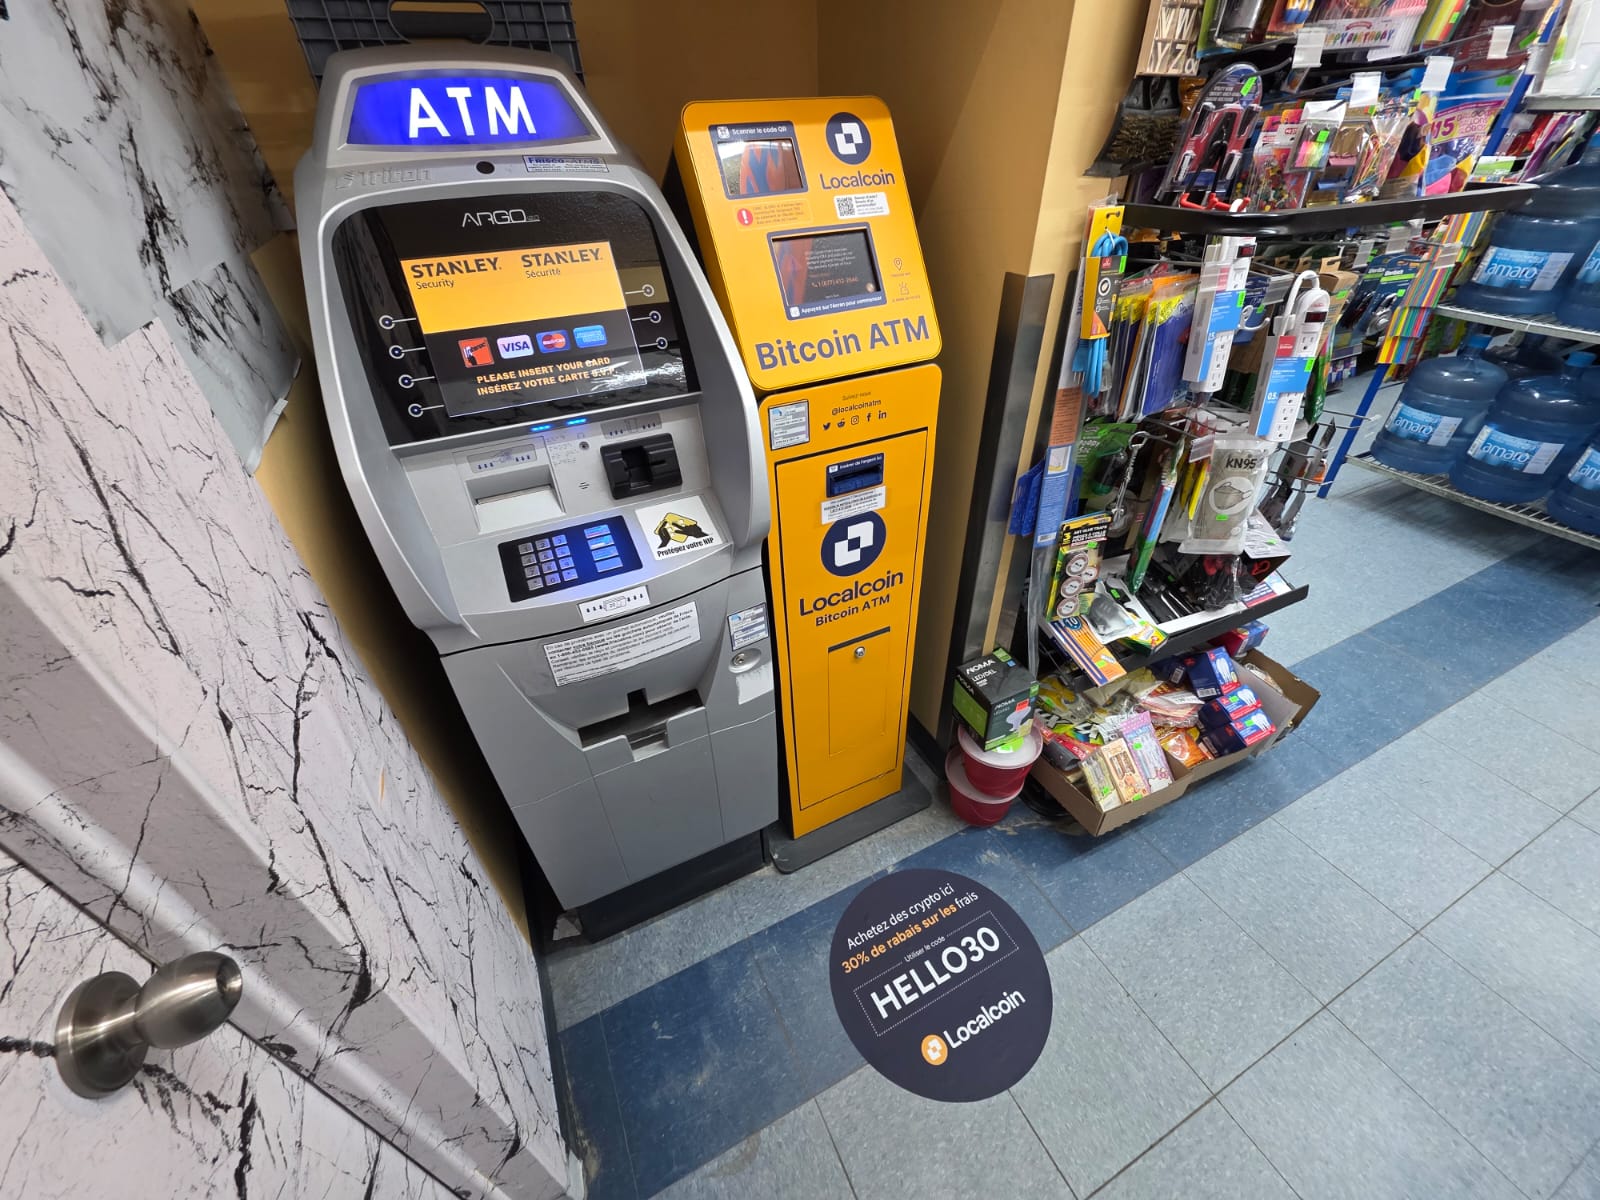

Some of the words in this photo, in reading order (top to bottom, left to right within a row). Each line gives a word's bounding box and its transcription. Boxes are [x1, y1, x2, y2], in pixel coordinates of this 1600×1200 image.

[409, 86, 537, 138] ATM
[819, 169, 896, 190] Localcoin
[410, 257, 499, 279] STANLEY
[521, 248, 601, 268] STANLEY
[416, 279, 455, 290] Security
[526, 268, 561, 279] Sécurité
[502, 340, 531, 353] VISA
[755, 329, 862, 370] Bitcoin
[869, 315, 930, 350] ATM
[476, 371, 515, 384] PLEASE
[518, 365, 554, 378] INSERT
[555, 360, 584, 373] YOUR
[584, 356, 611, 369] CARD
[477, 382, 521, 396] INSÉREZ
[523, 376, 556, 389] VOTRE
[557, 370, 590, 383] CARTE
[831, 399, 882, 415] @localcoinatm
[1225, 457, 1258, 470] KN95
[657, 544, 686, 558] Protégez
[686, 541, 702, 552] votre
[702, 537, 714, 548] NIP
[800, 570, 904, 617] Localcoin
[815, 604, 859, 627] Bitcoin
[862, 594, 891, 611] ATM
[1064, 617, 1078, 628] 10
[966, 659, 996, 675] NOMA
[846, 921, 890, 950] Achetez
[888, 908, 910, 927] des
[908, 891, 941, 917] crypto
[940, 882, 955, 898] ici
[841, 949, 871, 974] 30%
[870, 942, 887, 959] de
[886, 921, 922, 949] rabais
[921, 912, 940, 930] sur
[938, 902, 957, 920] les
[954, 890, 979, 909] frais
[903, 946, 925, 963] Utiliser
[924, 944, 931, 953] le
[930, 935, 946, 949] code
[870, 926, 1000, 1019] HELLO30
[943, 989, 1027, 1050] Localcoin
